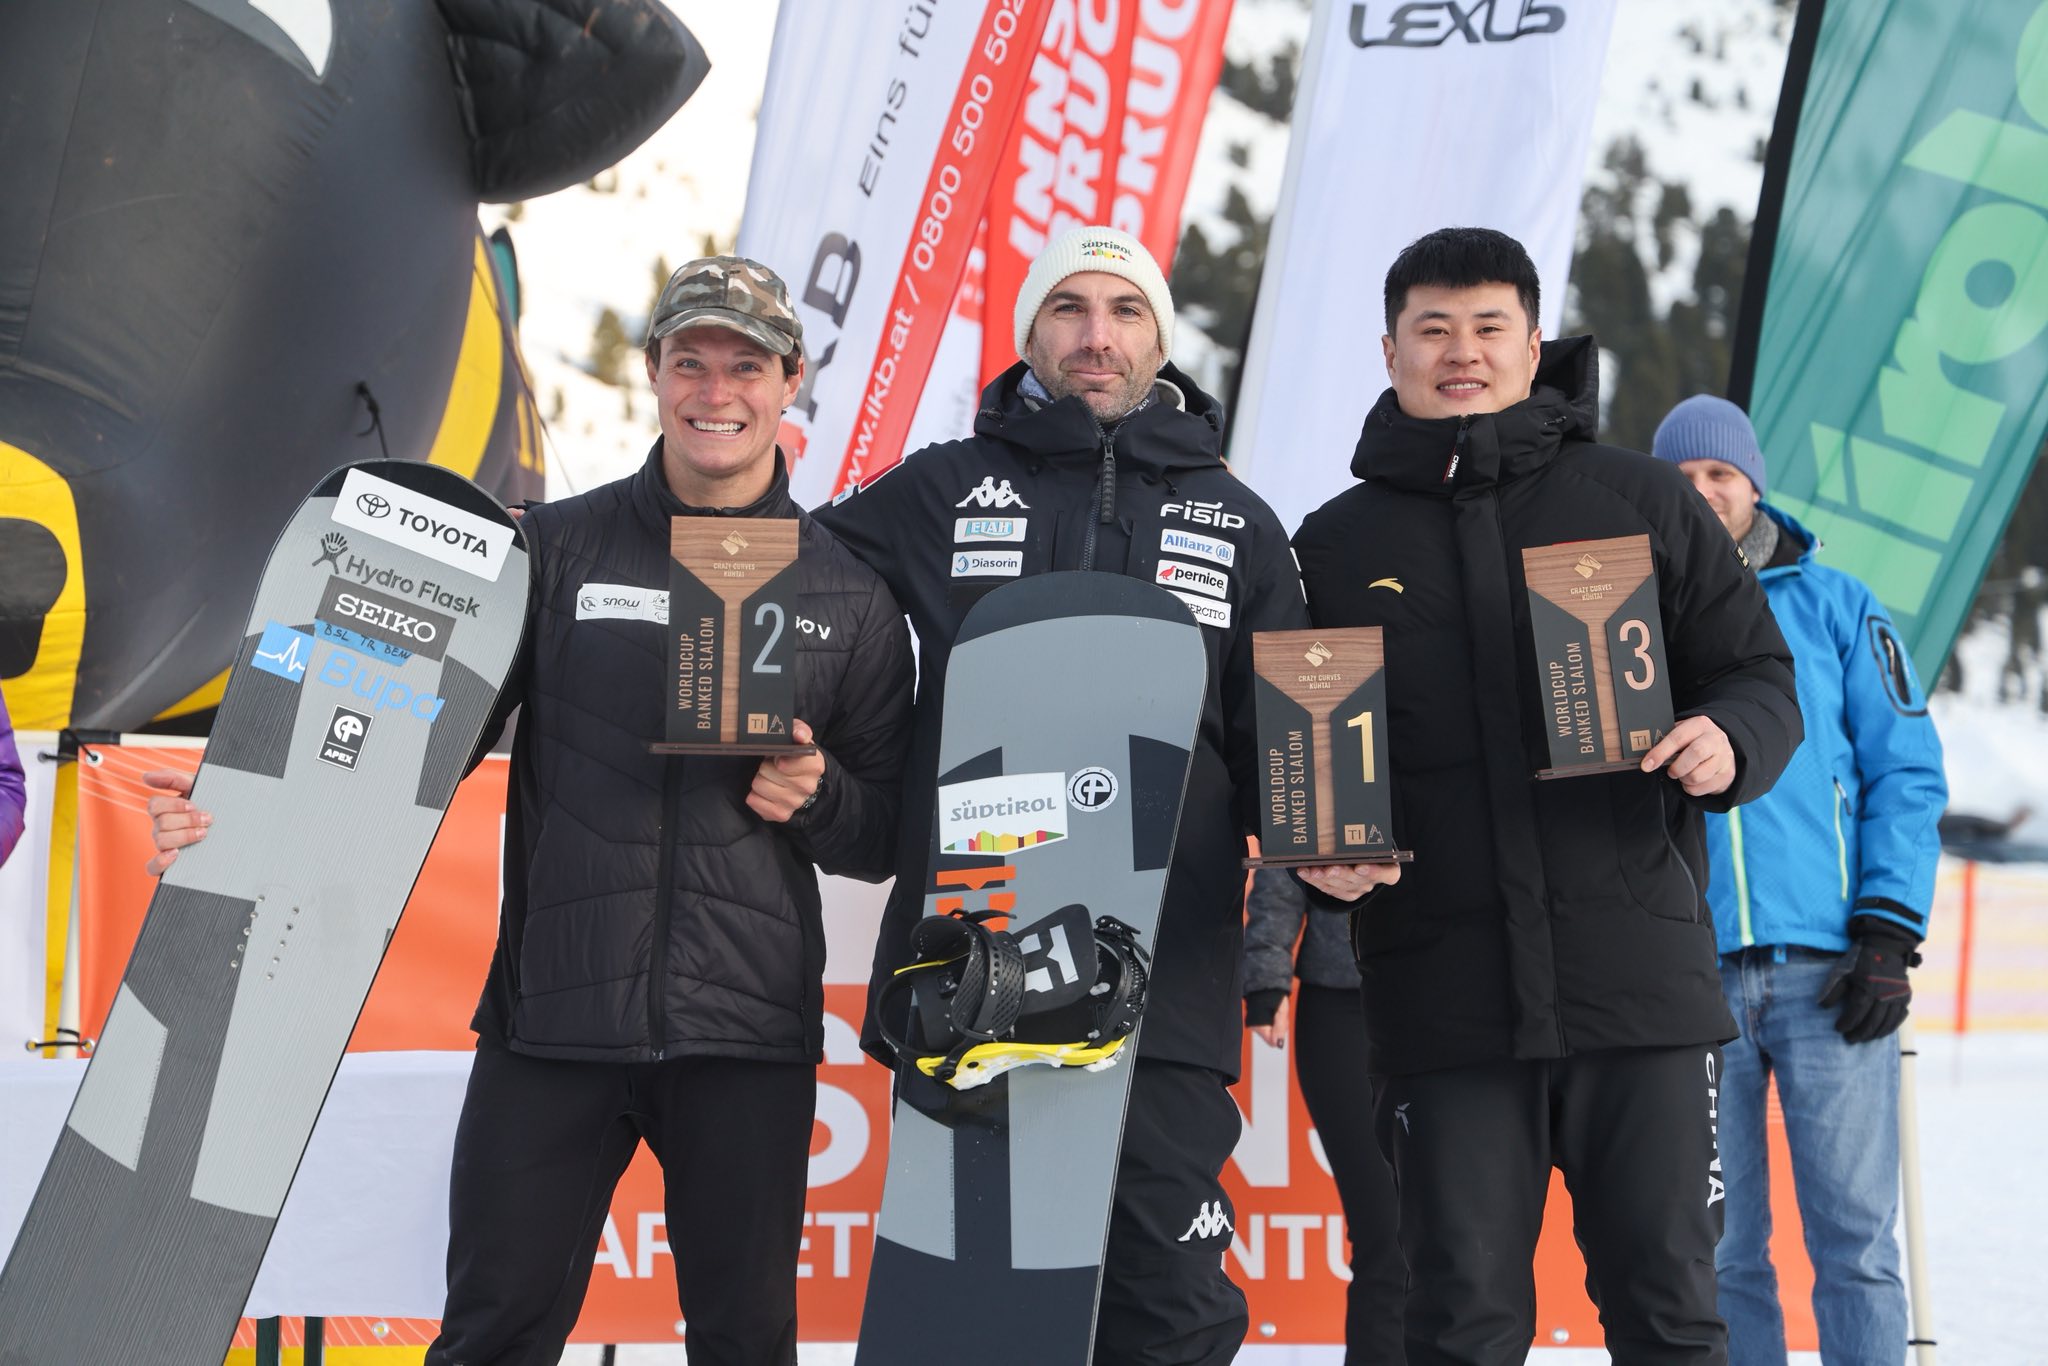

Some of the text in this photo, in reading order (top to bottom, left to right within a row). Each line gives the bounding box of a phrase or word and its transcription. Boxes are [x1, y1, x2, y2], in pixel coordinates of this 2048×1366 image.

[1348, 0, 1566, 48] LEXUS
[844, 308, 914, 488] ww.ikb.at
[913, 165, 961, 271] 0800
[952, 74, 993, 156] 500
[399, 508, 488, 558] TOYOTA
[971, 558, 1018, 568] Diasorin
[1164, 534, 1213, 554] Allianz
[346, 555, 481, 618] Hydro Flask
[603, 597, 641, 608] snow
[1175, 568, 1224, 589] pernice
[1186, 603, 1226, 621] ERCITO
[324, 624, 349, 642] BSL
[360, 634, 376, 651] TR
[334, 593, 436, 643] SEIKO
[752, 602, 785, 674] 2
[318, 651, 446, 722] Bupa
[678, 633, 695, 710] WORLDCUP
[697, 616, 715, 730] BANKED SLALOM
[1619, 619, 1656, 690] 3
[1550, 661, 1573, 738] WORLDCUP
[1566, 642, 1594, 754] BANKED SLALOM
[324, 748, 354, 764] APEX
[1347, 711, 1375, 783] 1
[1270, 748, 1287, 826] WORLDCUP
[1288, 730, 1308, 844] BANKED SLALOM
